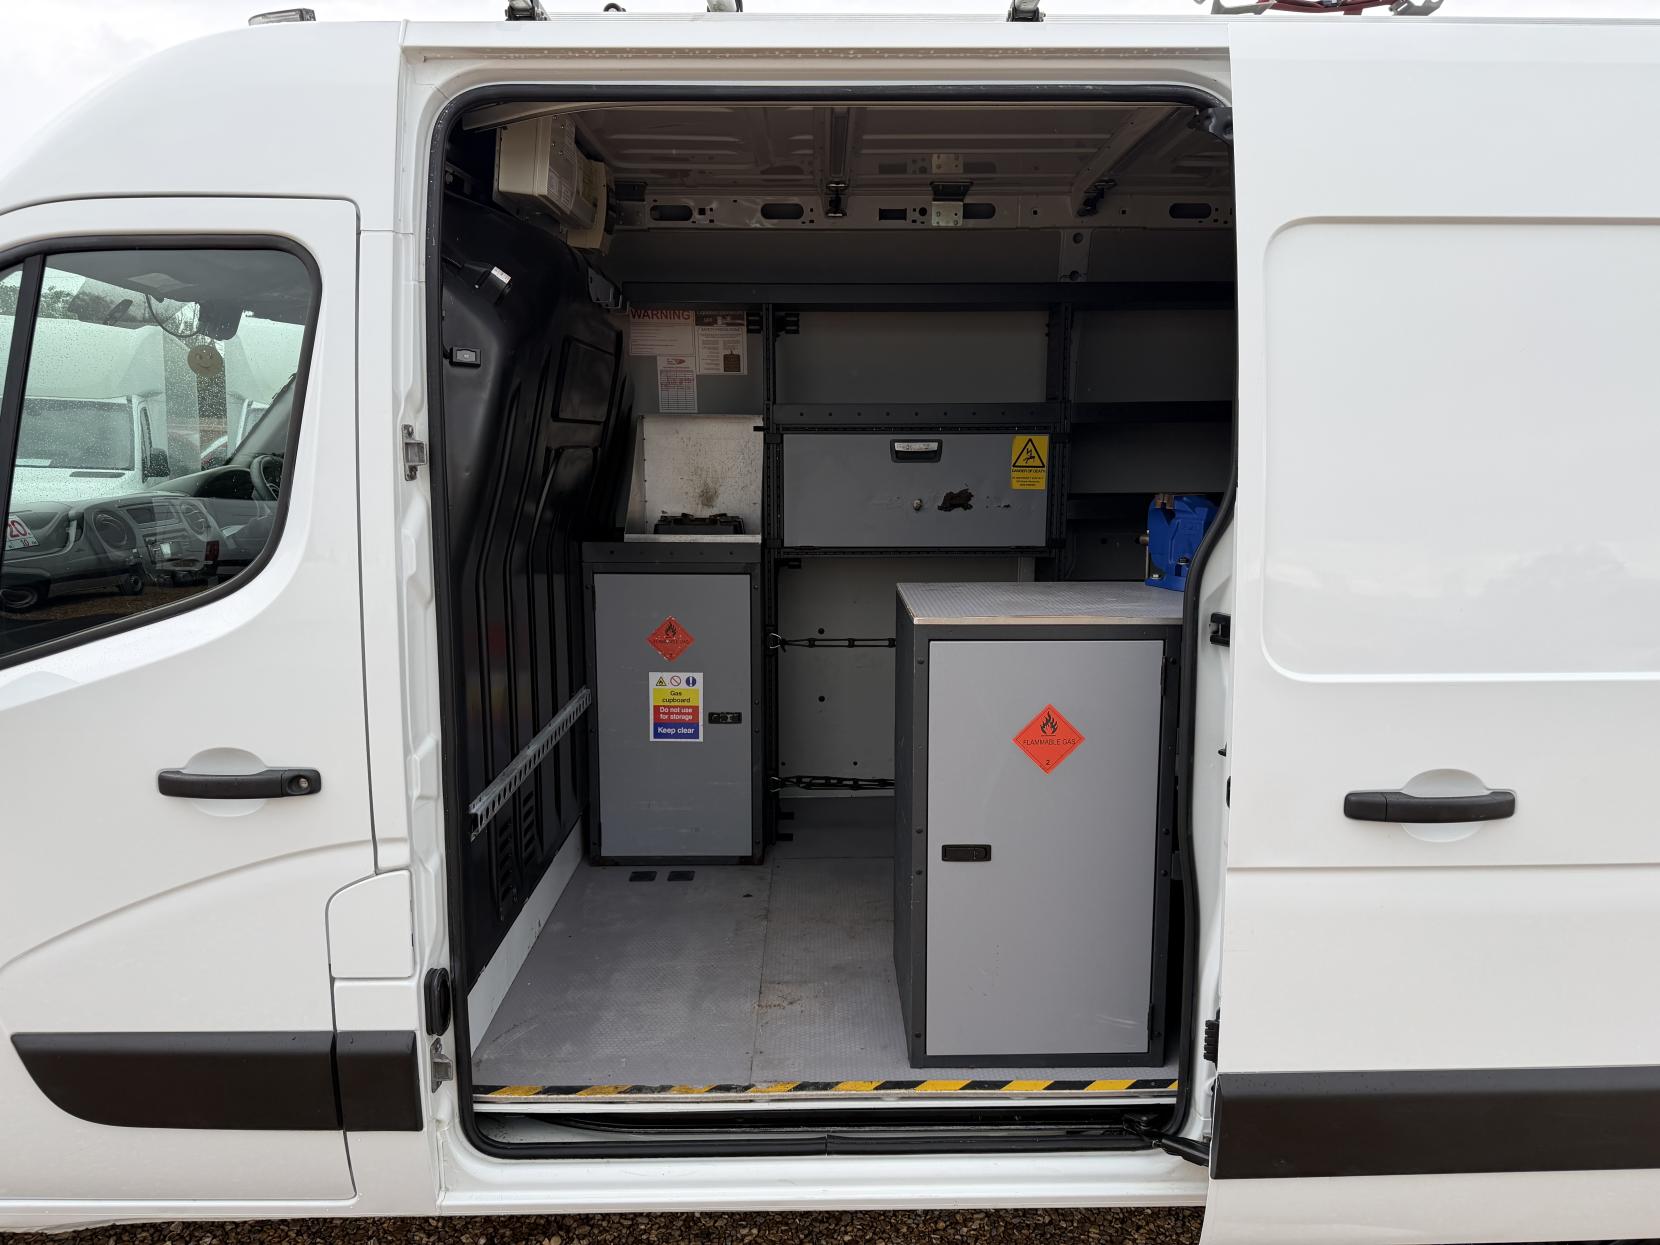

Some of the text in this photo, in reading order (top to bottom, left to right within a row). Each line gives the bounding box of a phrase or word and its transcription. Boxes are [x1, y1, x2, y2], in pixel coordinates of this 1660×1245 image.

[631, 309, 690, 320] WARNING
[670, 713, 693, 721] storage
[657, 726, 695, 735] Keep clear
